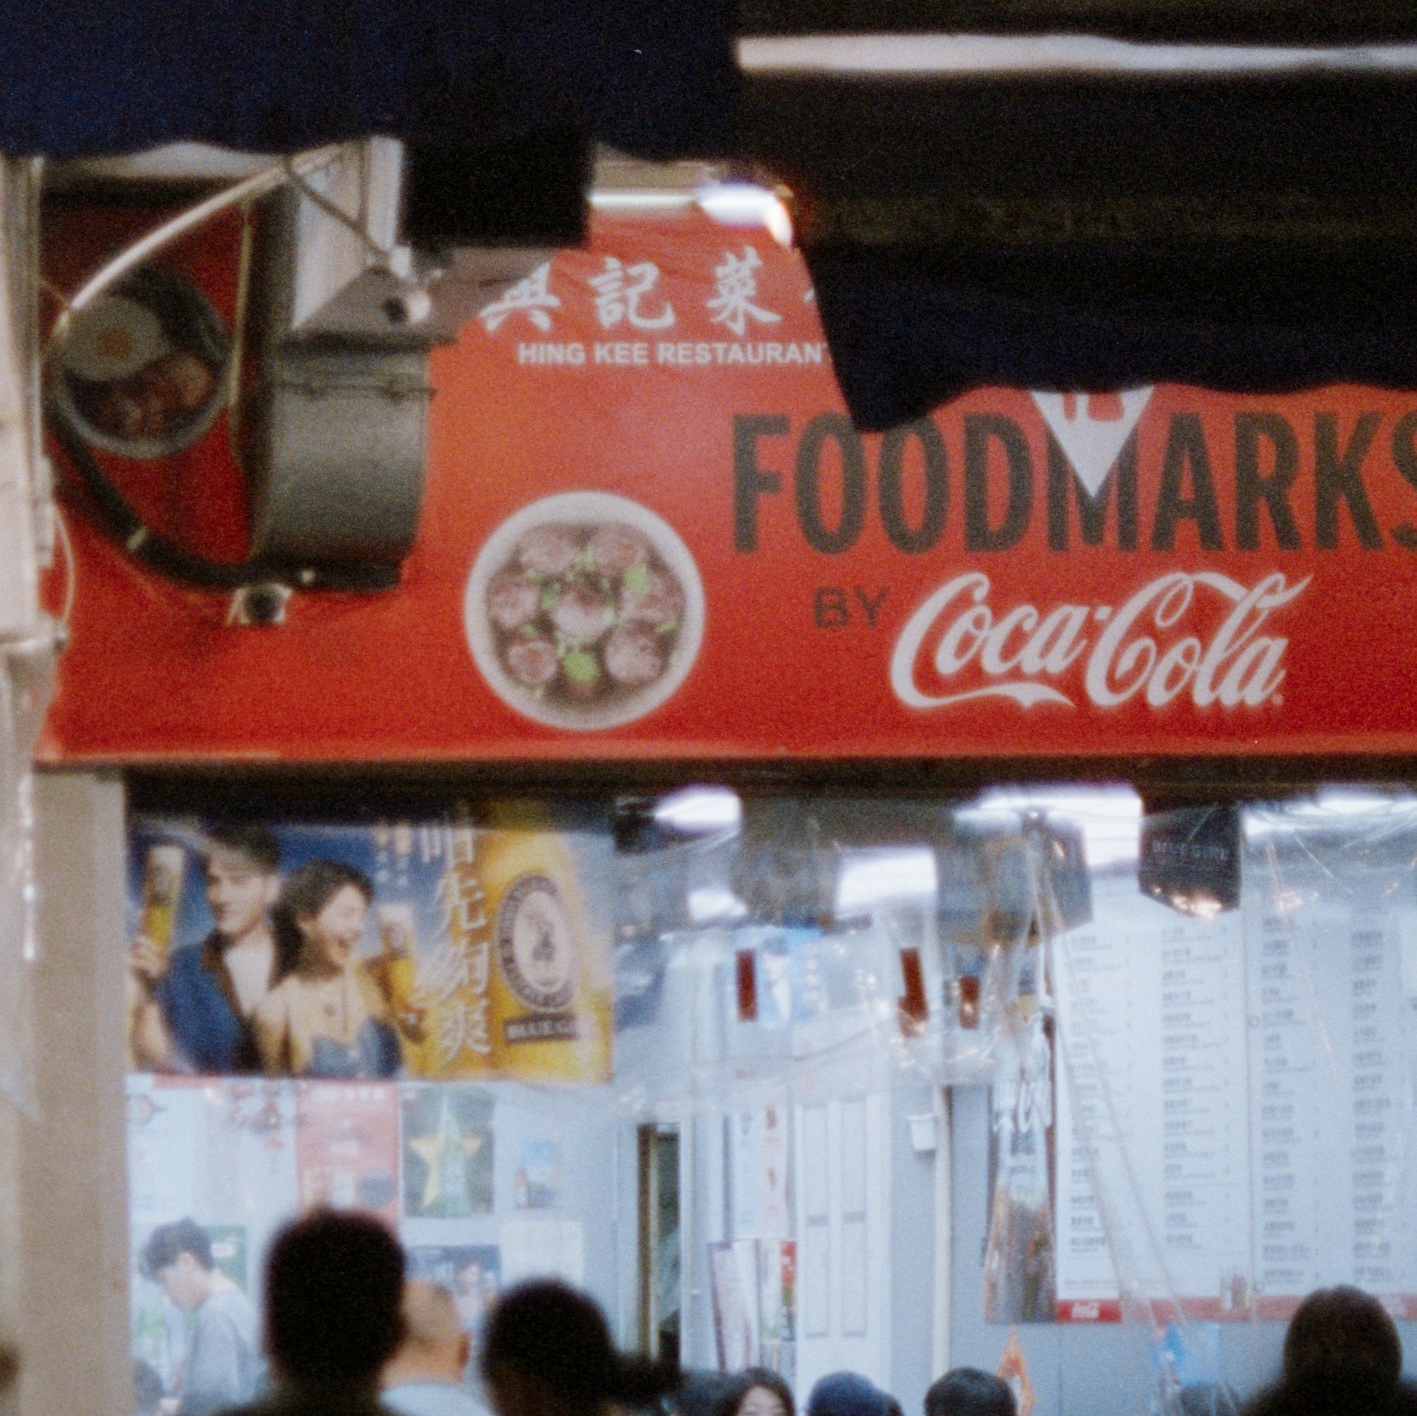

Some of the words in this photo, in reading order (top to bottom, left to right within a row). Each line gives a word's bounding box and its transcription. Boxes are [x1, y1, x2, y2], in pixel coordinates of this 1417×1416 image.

[518, 342, 586, 365] HING
[593, 342, 649, 365] KEE
[812, 586, 889, 628] BY
[890, 571, 1313, 708] Coca-Cola
